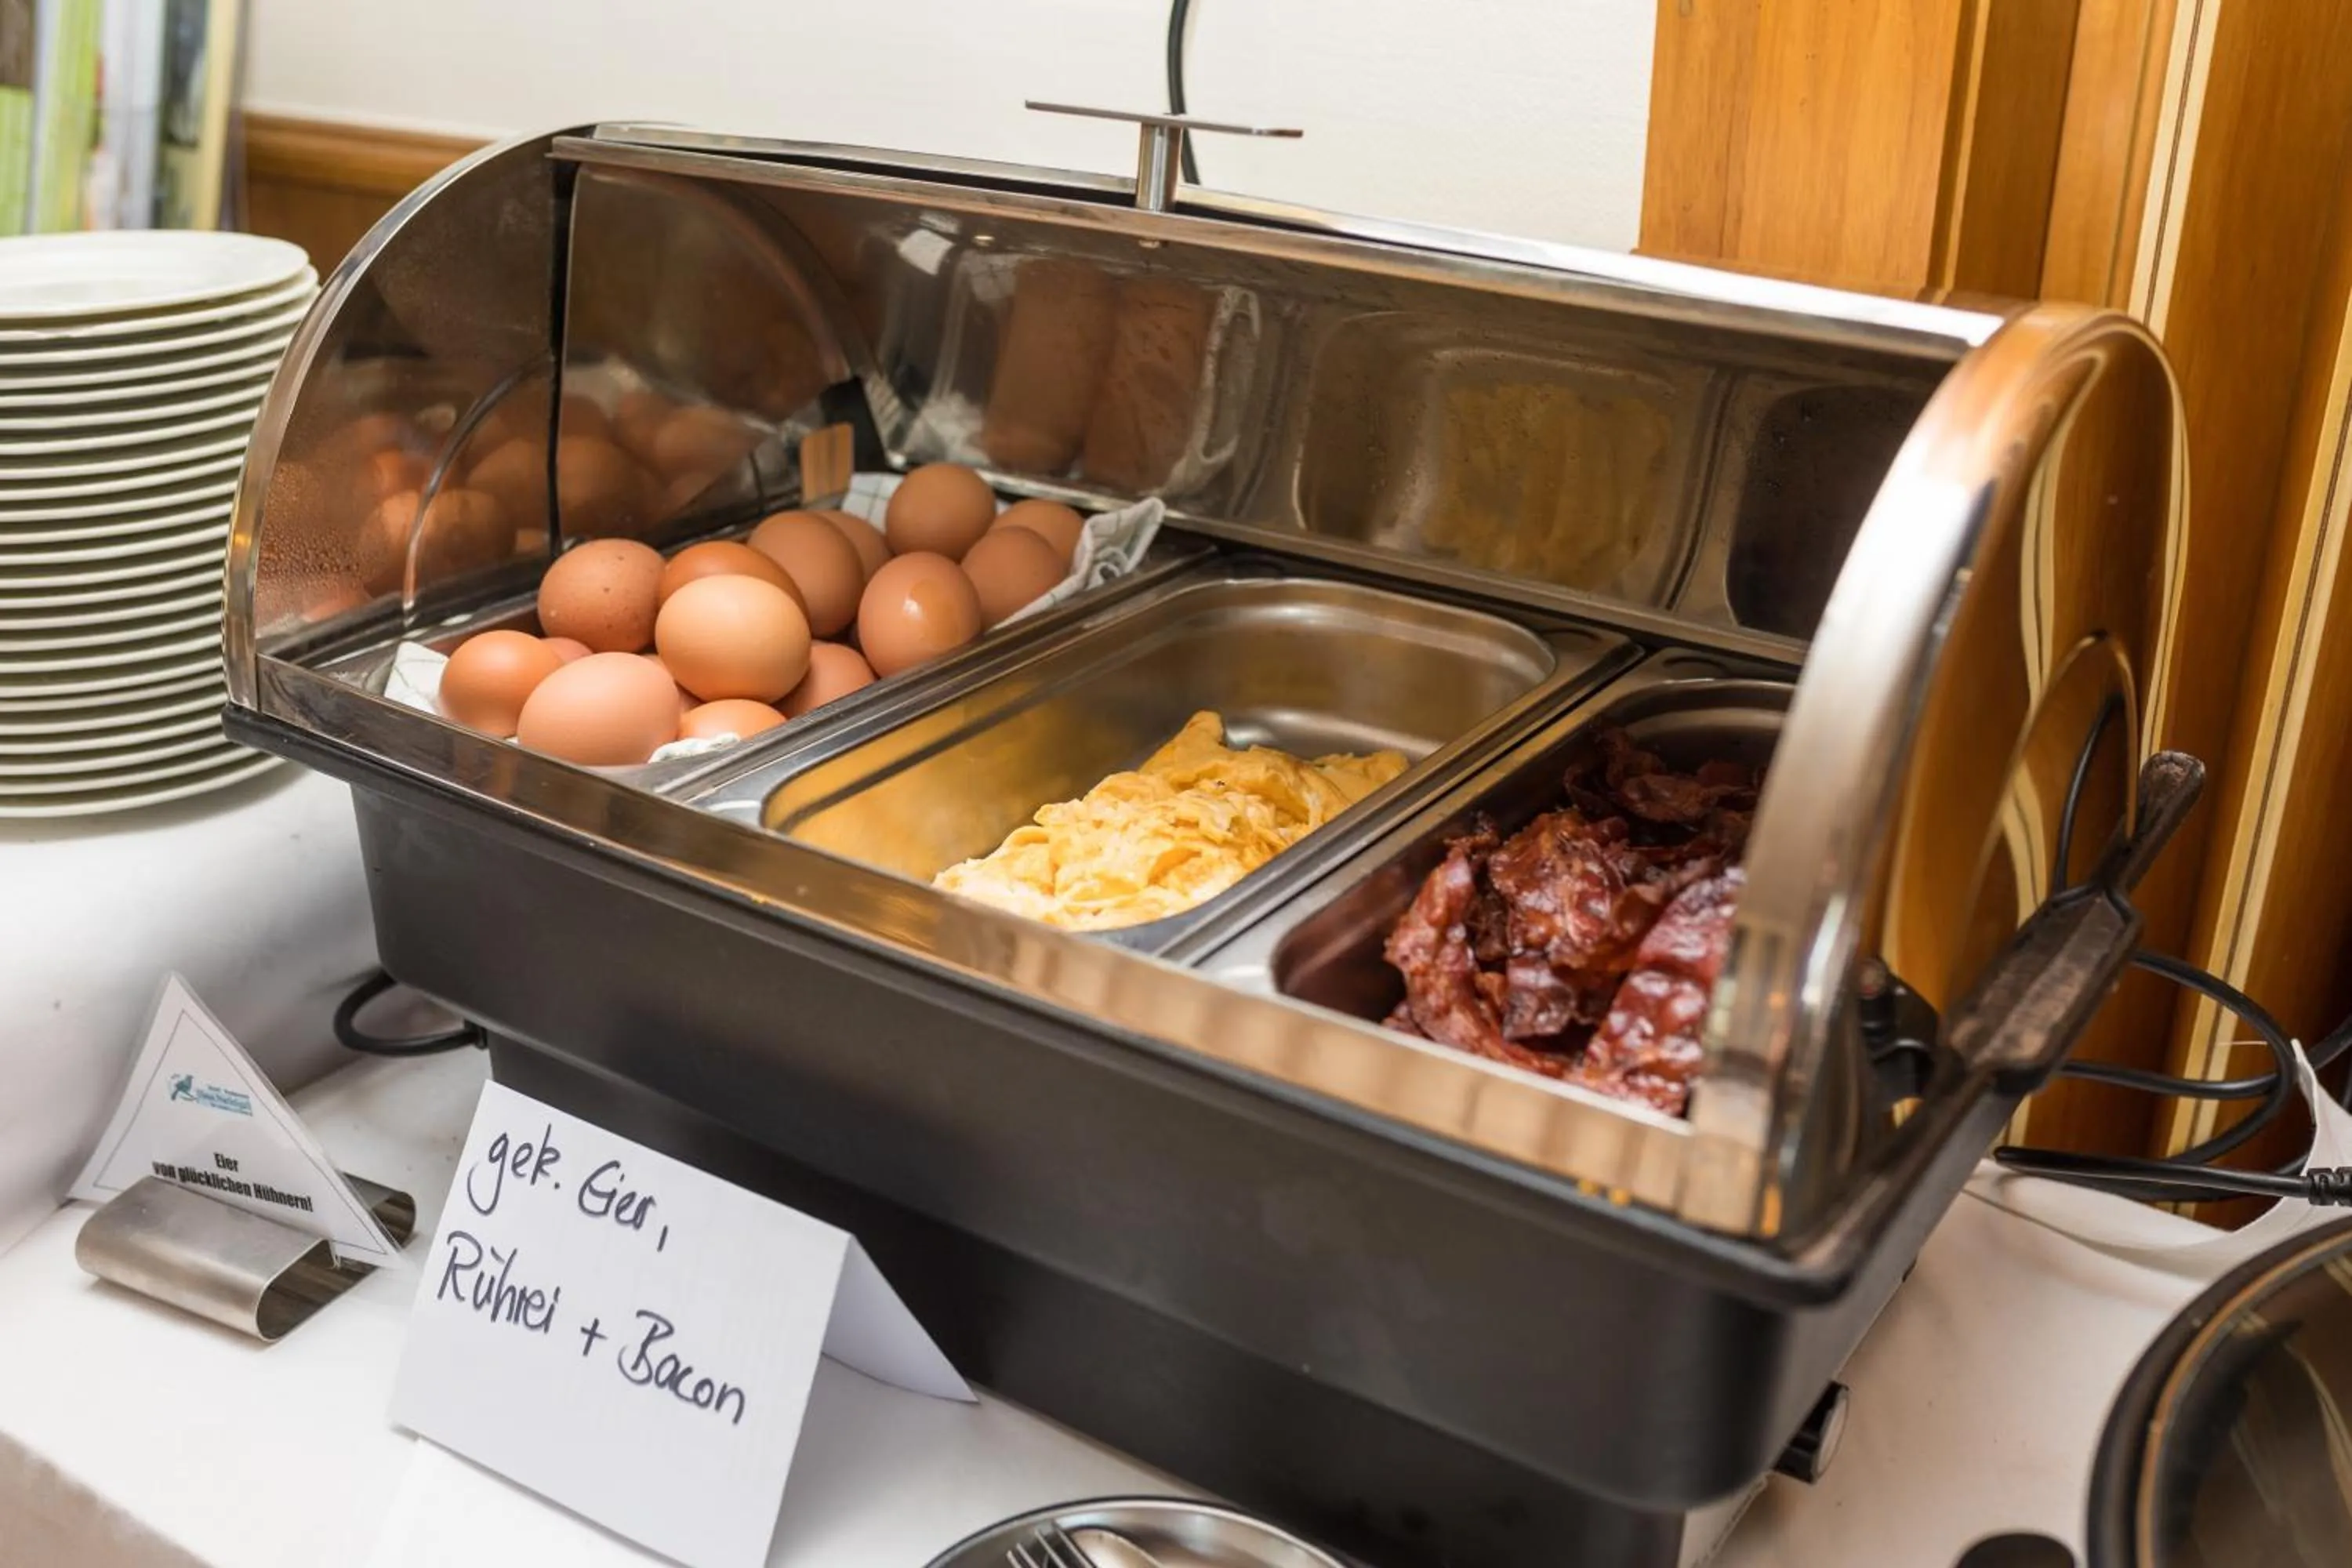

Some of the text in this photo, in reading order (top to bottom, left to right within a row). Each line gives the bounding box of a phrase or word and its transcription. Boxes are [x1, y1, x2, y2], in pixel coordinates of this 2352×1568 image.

[152, 1160, 314, 1212] von glücklichen Hühnern!
[213, 1152, 239, 1173] Eier
[466, 1123, 561, 1217] gek.
[437, 1230, 746, 1425] Rührei + Bacon
